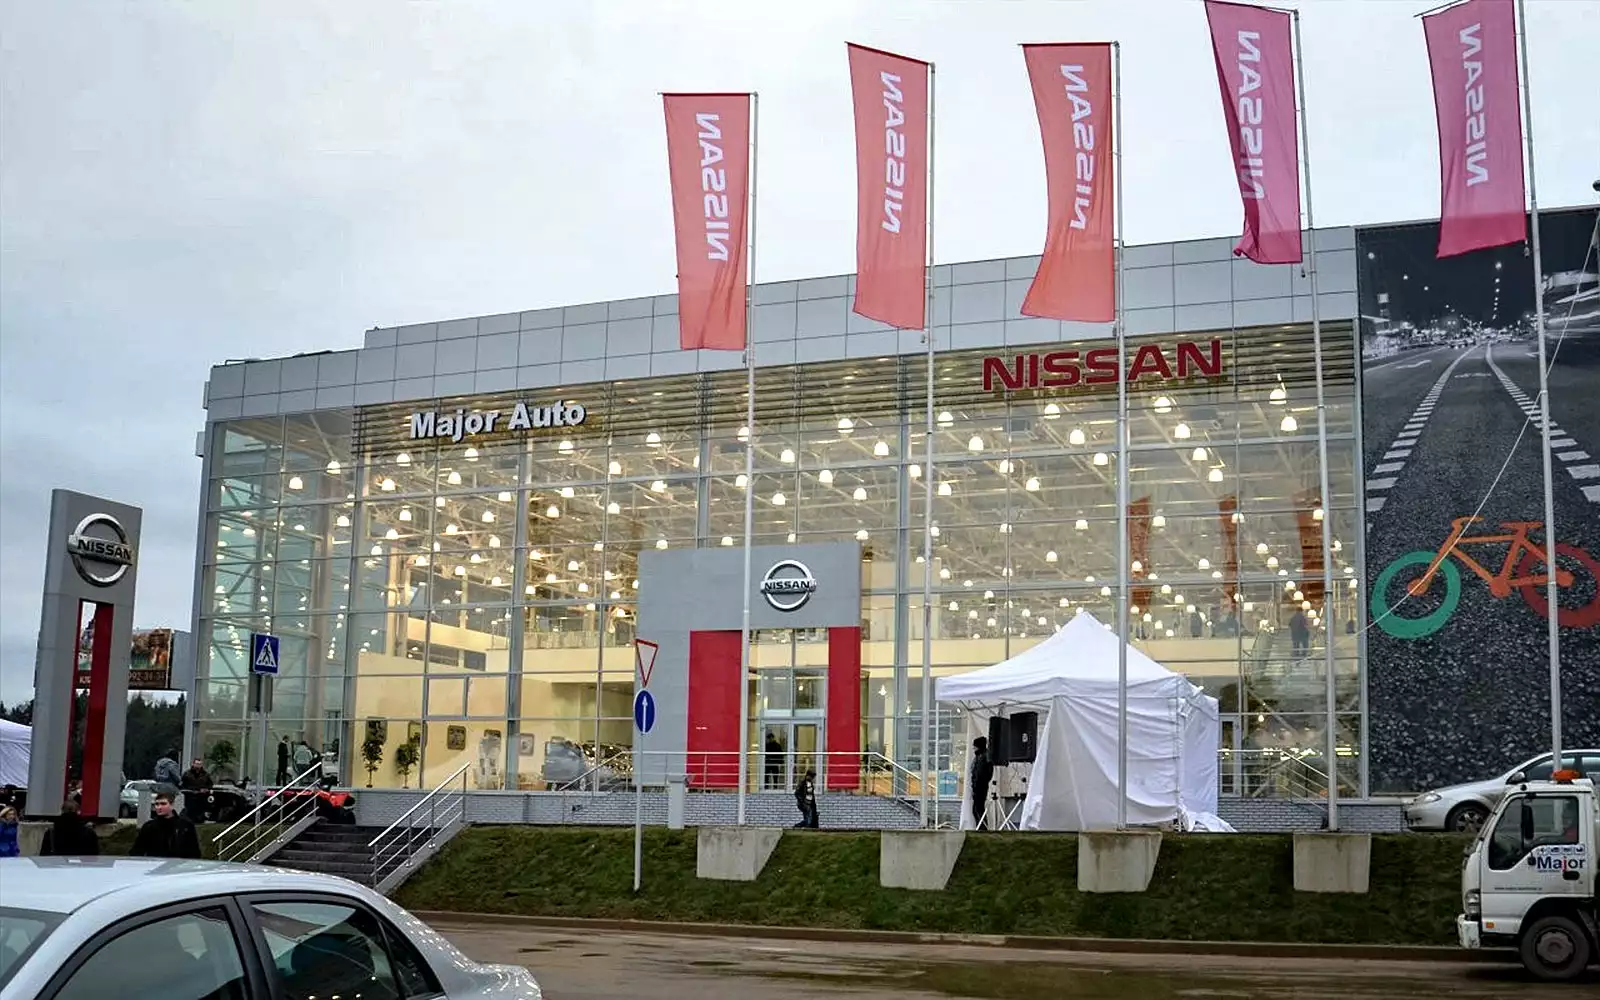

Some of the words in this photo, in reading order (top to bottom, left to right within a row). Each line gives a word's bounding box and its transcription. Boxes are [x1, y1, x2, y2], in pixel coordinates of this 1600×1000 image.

[982, 339, 1222, 391] NISSAN
[409, 408, 500, 443] Major
[507, 400, 587, 430] Auto
[77, 539, 132, 560] NISSAN
[764, 580, 810, 591] NISSAN
[1537, 856, 1586, 872] Major
